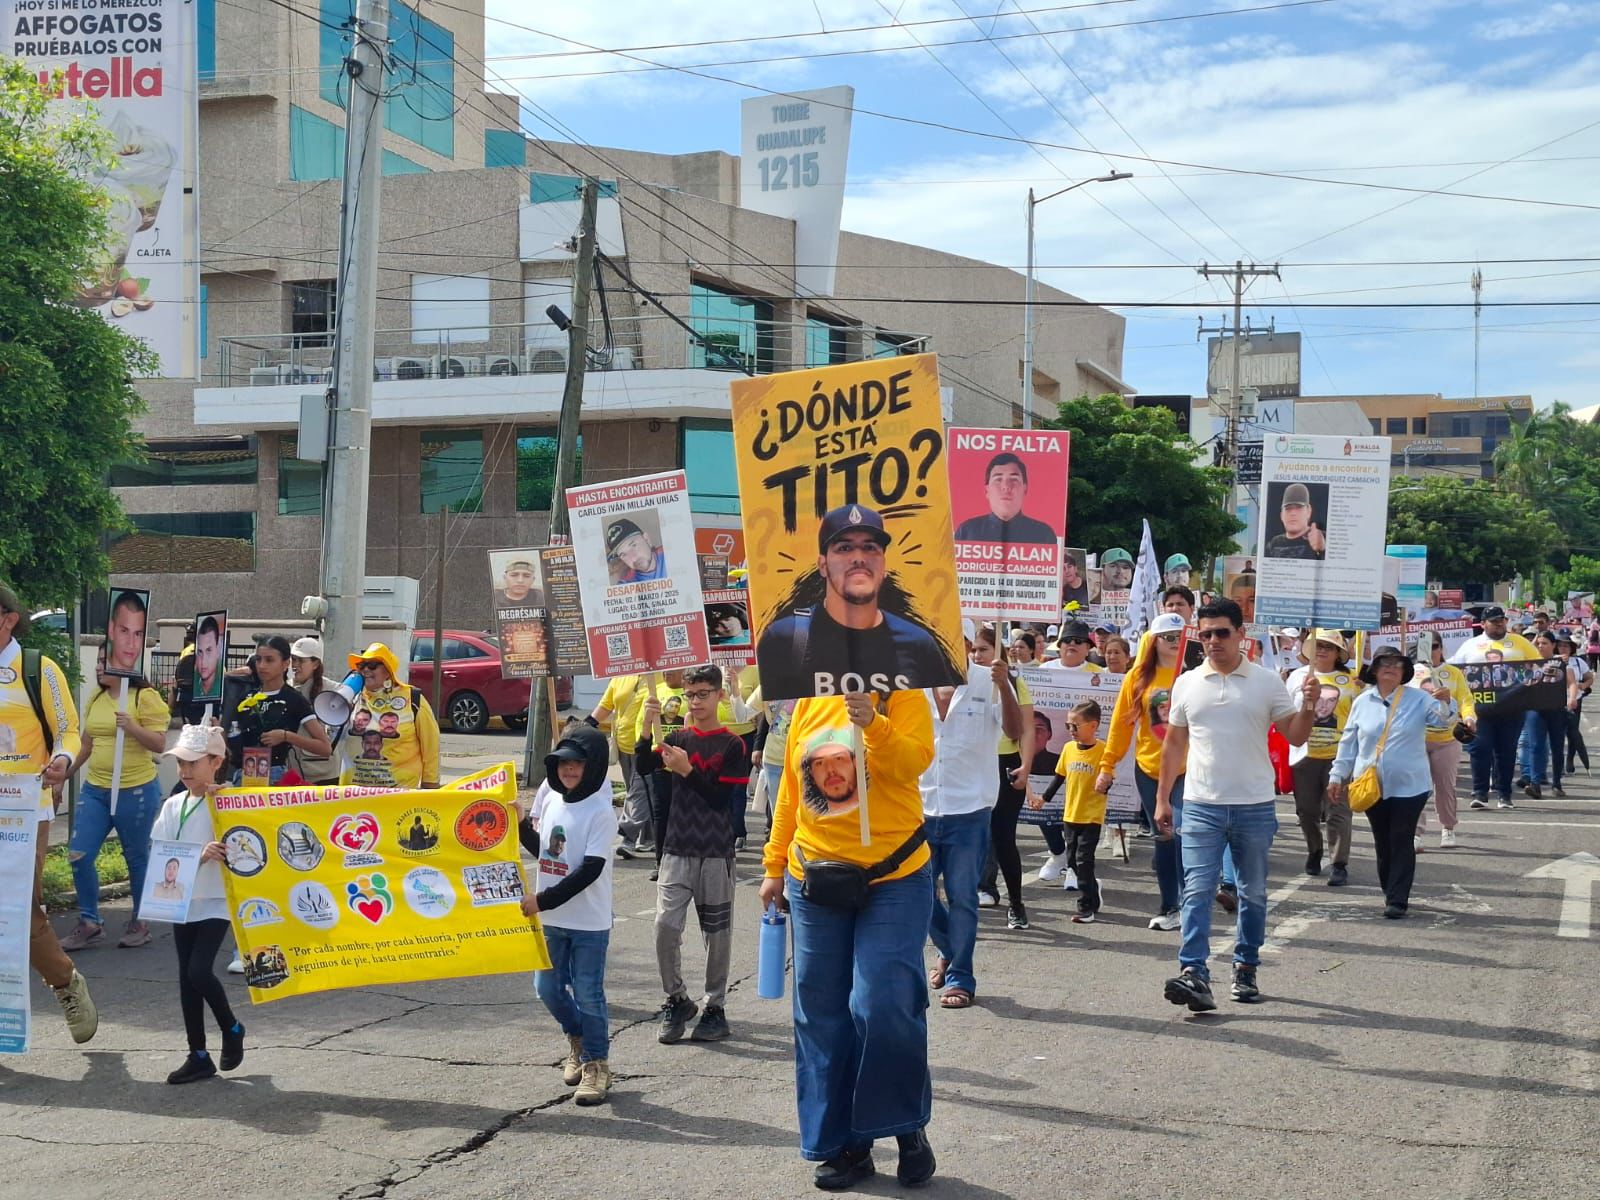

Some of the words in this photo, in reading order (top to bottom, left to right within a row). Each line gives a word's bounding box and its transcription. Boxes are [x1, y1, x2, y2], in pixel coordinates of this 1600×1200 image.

[61, 0, 78, 9] ME
[82, 0, 97, 9] LO
[14, 13, 162, 36] AFFOGATOS
[14, 38, 117, 56] PRUÉBALOS
[122, 38, 162, 53] CON
[756, 125, 826, 151] GUADALUPE
[758, 151, 820, 192] 1215
[137, 248, 171, 257] CAJETA
[752, 370, 913, 461] ¿DÓNDE
[815, 420, 878, 460] ESTÁ
[956, 434, 996, 451] NOS
[1001, 435, 1061, 453] FALTA
[1278, 461, 1321, 473] Ayudanos
[761, 428, 943, 536] TITO?
[576, 490, 608, 507] ¡HASTA
[610, 479, 677, 499] ENCONTRARTE!
[578, 505, 606, 518] CARLOS
[608, 502, 625, 513] IVÁN
[627, 498, 655, 510] MILLÁN
[657, 494, 679, 505] URÍAS
[955, 544, 1003, 560] JESUS
[1008, 547, 1053, 561] ALAN
[957, 561, 1004, 573] ODRIGUEZ
[1006, 564, 1056, 574] CAMACHO
[607, 580, 673, 598] DESAPARECIDO
[1006, 578, 1014, 586] DE
[638, 593, 660, 601] MARZO
[973, 588, 981, 596] EN
[982, 588, 994, 597] SAN
[679, 614, 698, 623] CASA!
[814, 671, 911, 697] BOSS
[215, 795, 265, 810] BRIGADA
[268, 790, 319, 806] ESTATAL
[324, 788, 339, 801] DE
[0, 832, 30, 842] RIGUEZ
[314, 943, 334, 953] cada
[336, 939, 373, 951] nombre,
[375, 940, 391, 951] por
[393, 936, 414, 947] cada
[416, 932, 455, 944] historia,
[457, 932, 473, 944] por
[476, 928, 497, 938] cada
[294, 960, 338, 974] seguimos
[341, 956, 352, 966] de
[354, 956, 371, 967] pie,
[372, 953, 397, 963] hasta
